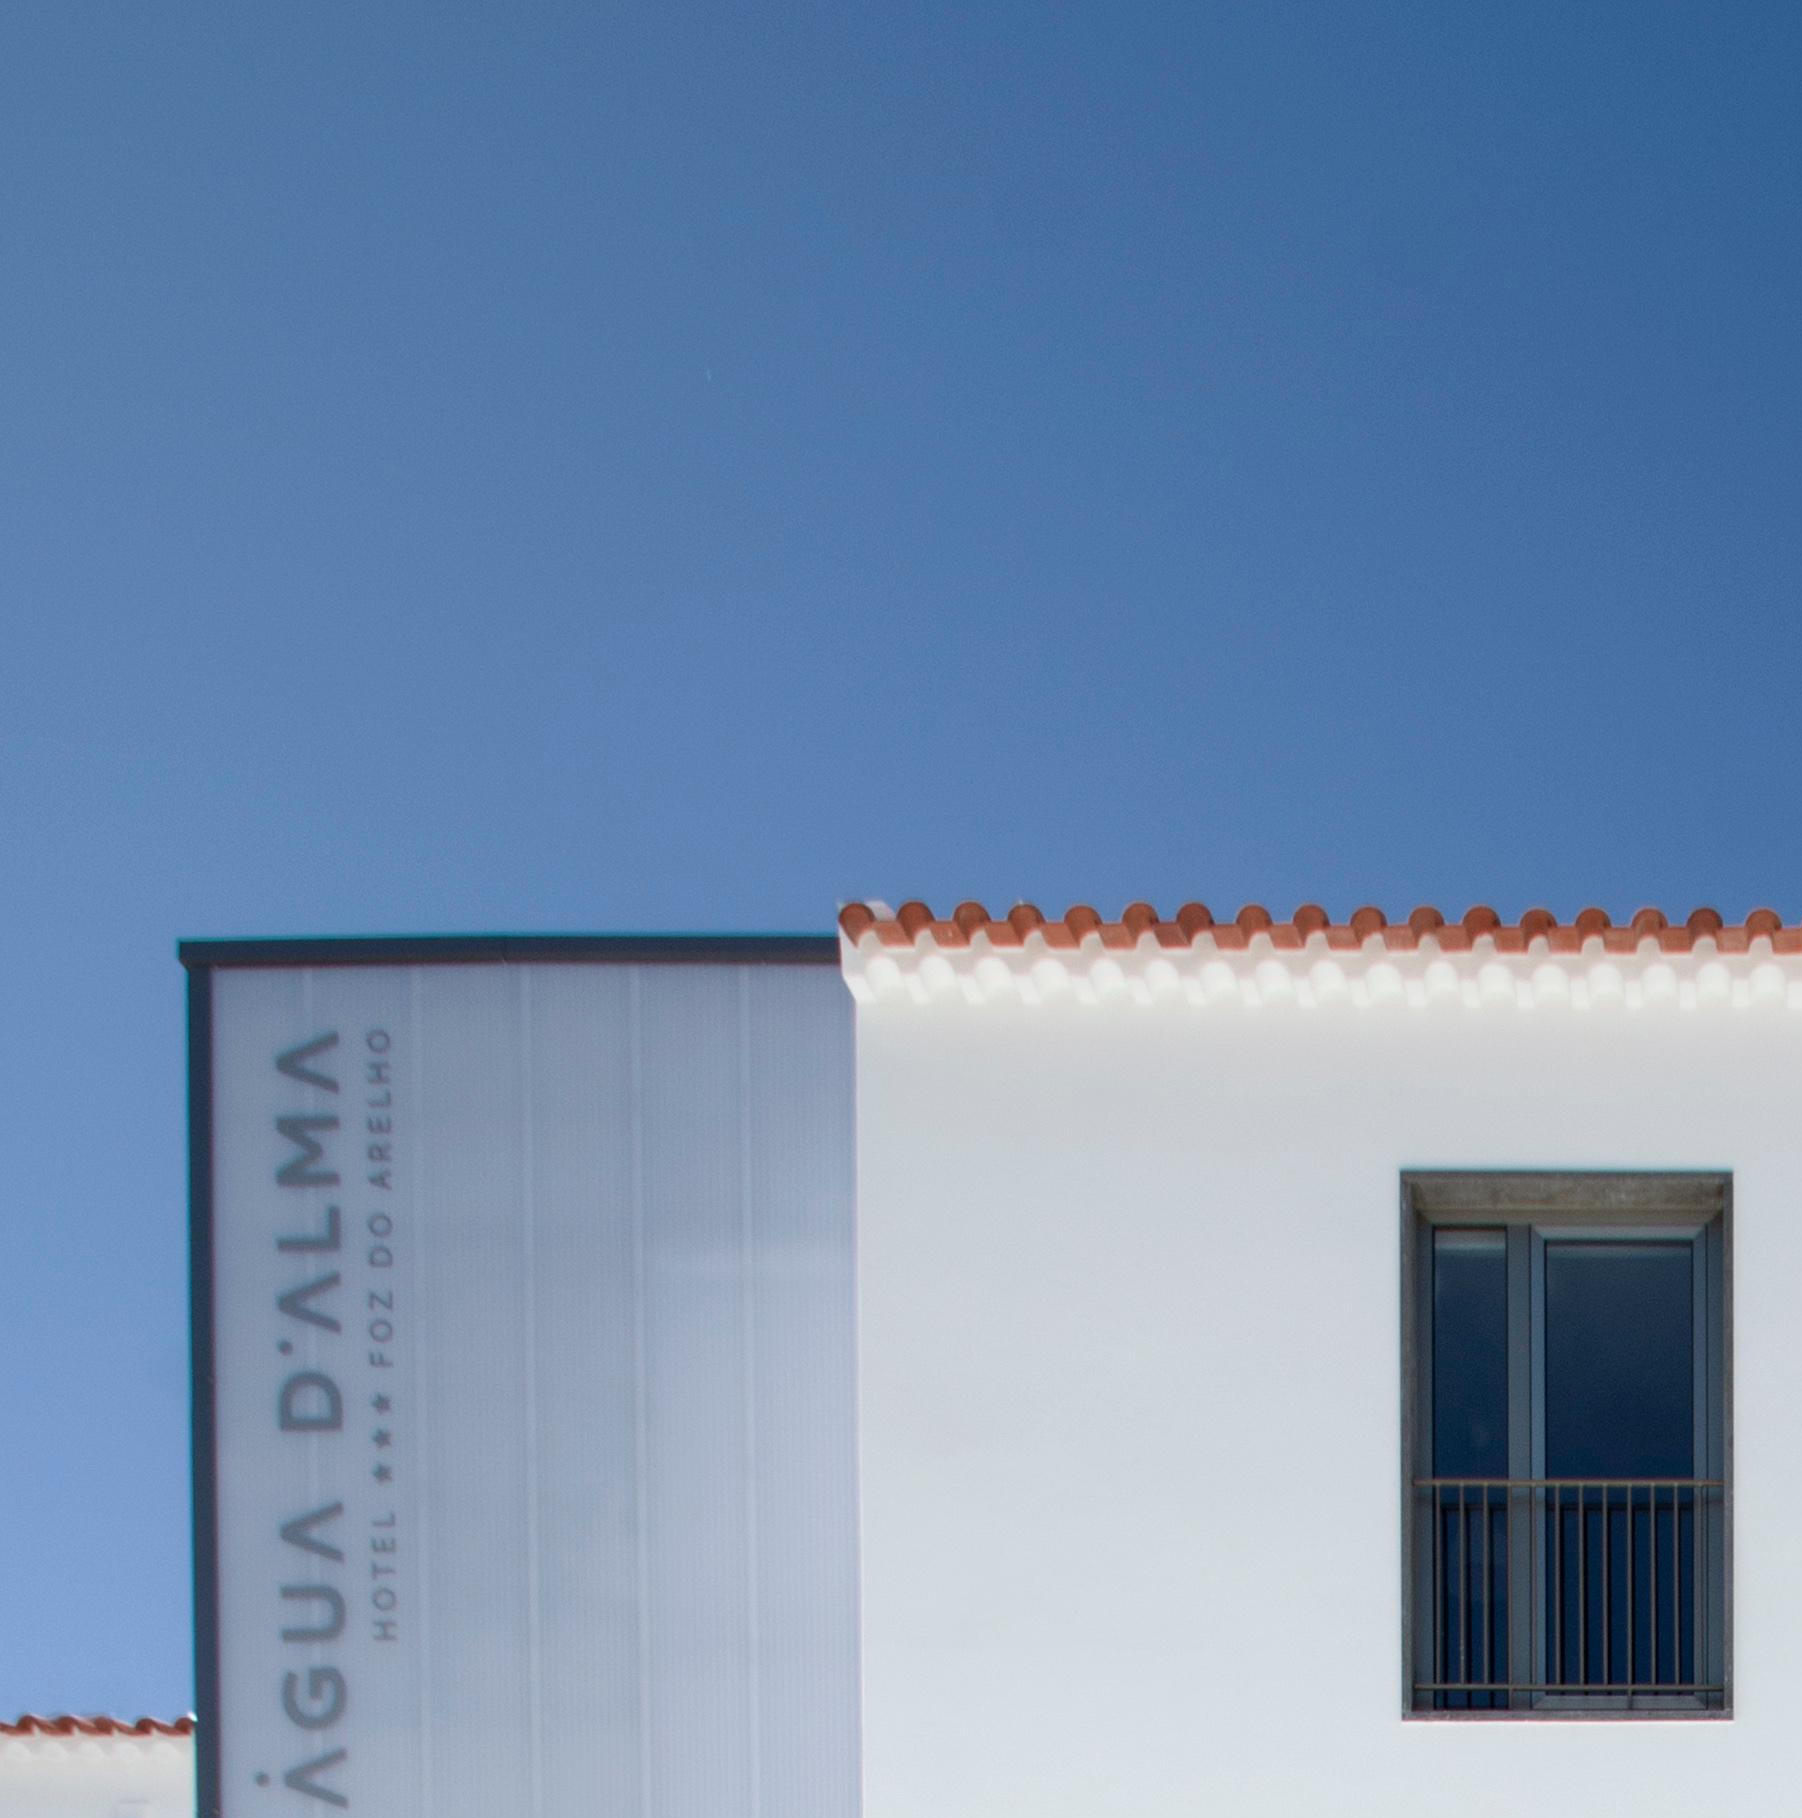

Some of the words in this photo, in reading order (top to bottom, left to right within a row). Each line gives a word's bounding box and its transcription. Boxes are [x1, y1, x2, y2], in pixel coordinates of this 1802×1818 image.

[366, 1028, 393, 1191] ARELHO
[367, 1212, 394, 1269] DO
[368, 1290, 394, 1368] FOZ
[370, 1511, 398, 1643] HOTEL
[254, 1500, 350, 1810] ÁGUA
